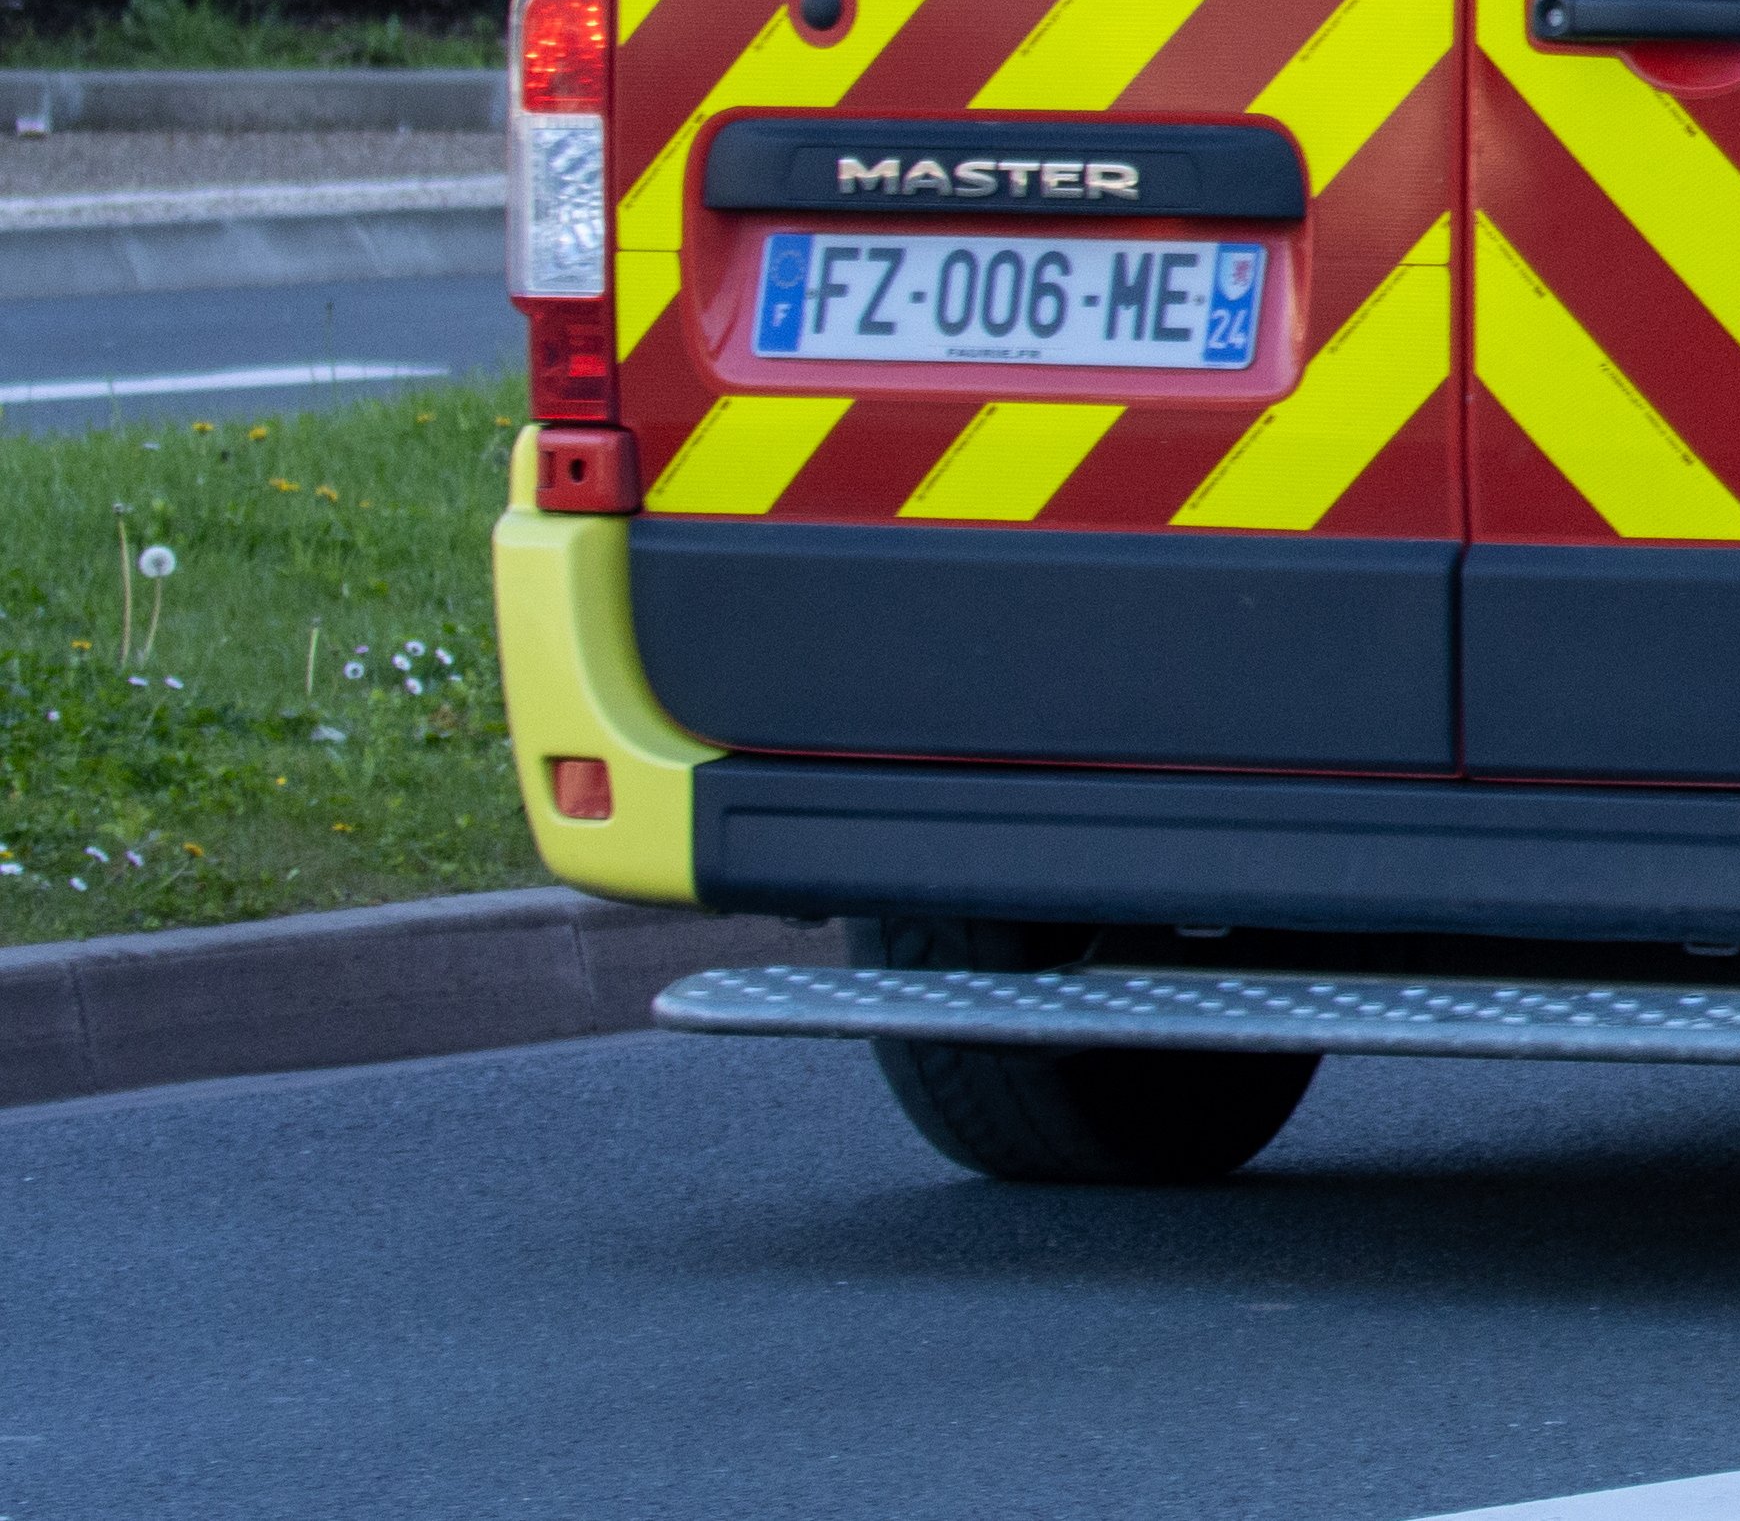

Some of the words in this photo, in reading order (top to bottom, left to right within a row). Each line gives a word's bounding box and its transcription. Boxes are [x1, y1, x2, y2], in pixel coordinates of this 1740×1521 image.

[837, 157, 1141, 201] MASTER
[771, 303, 792, 328] F
[812, 245, 1200, 343] FZ-006-ME
[1207, 309, 1248, 350] 24
